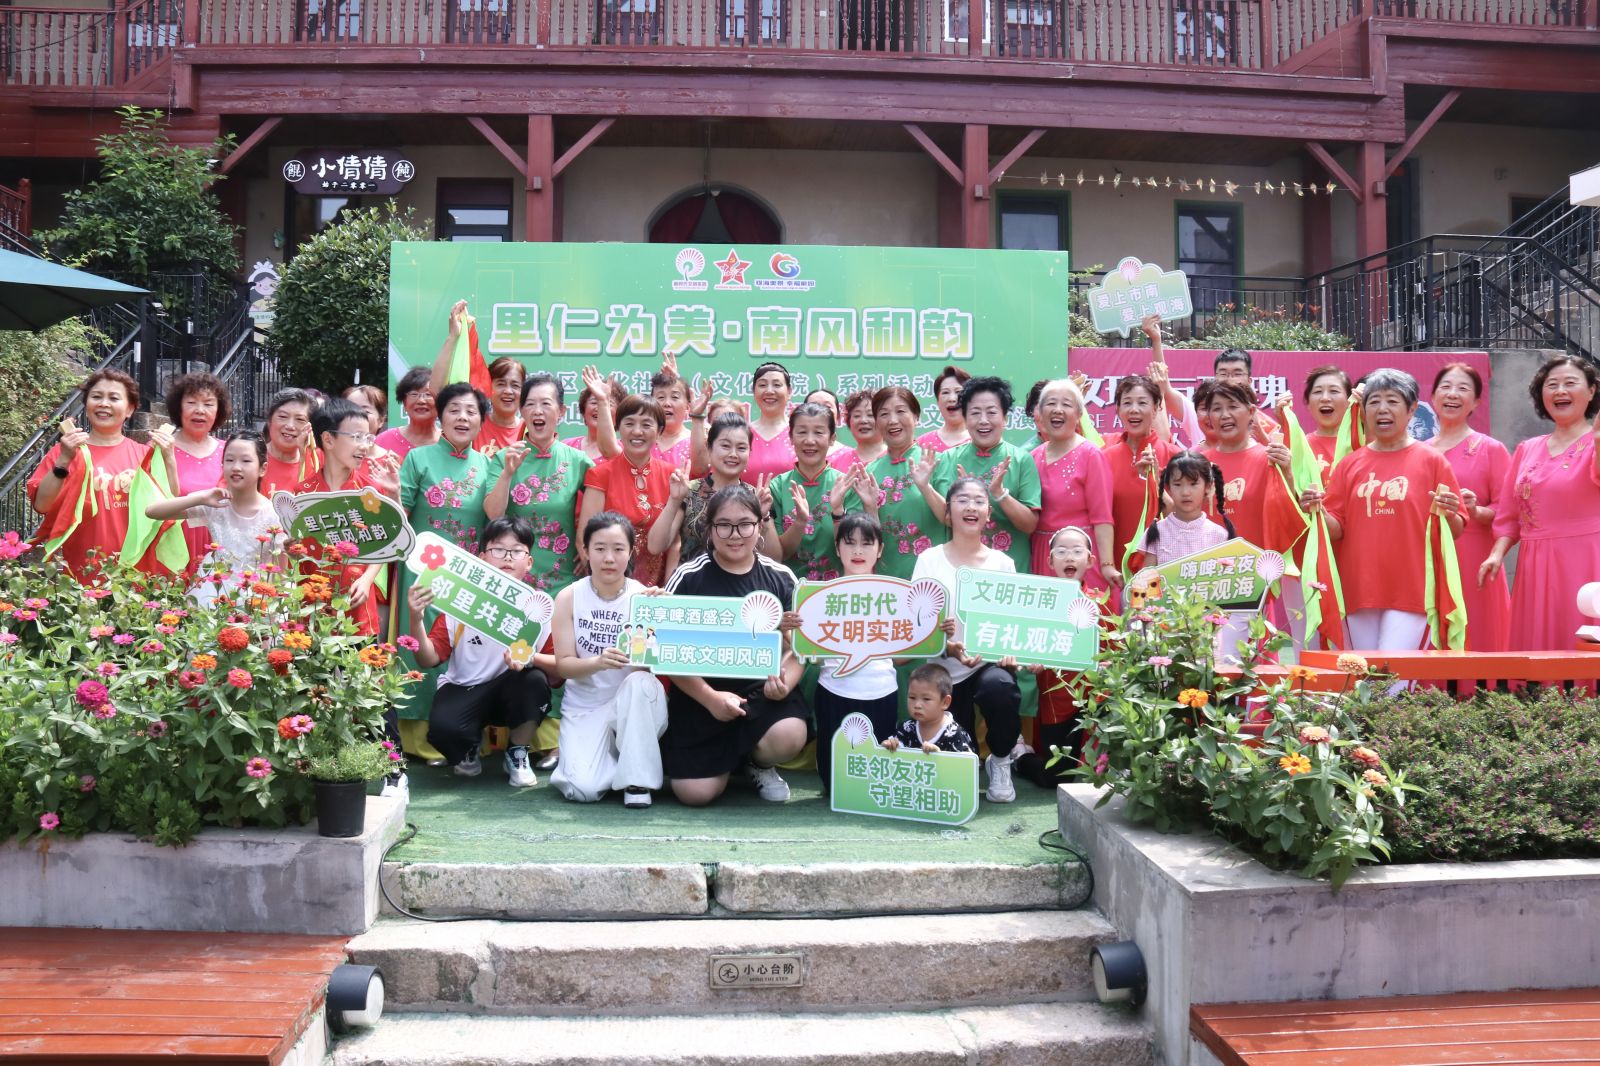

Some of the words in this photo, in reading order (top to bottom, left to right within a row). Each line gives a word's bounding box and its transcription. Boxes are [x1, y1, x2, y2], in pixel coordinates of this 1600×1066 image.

[311, 155, 388, 180] 小倩倩
[1097, 284, 1159, 309] 爱上市南
[489, 302, 973, 358] 里仁为美·南风和韵
[1357, 472, 1409, 518] 中国
[304, 509, 364, 532] 里仁为美
[326, 524, 388, 546] 南风和韵
[449, 556, 523, 605] 和谐社区
[825, 593, 897, 617] 新时代
[971, 579, 1059, 610] 文明市南
[431, 575, 524, 640] 邻里共建
[591, 610, 624, 623] WHERE
[636, 607, 735, 626] 共享啤酒盛会
[578, 618, 623, 633] GRASSROO
[817, 620, 914, 643] 文明实践
[577, 636, 605, 655] GREAT
[590, 632, 617, 644] MEETS
[976, 621, 1073, 656] 有礼观海
[659, 644, 773, 667] 同筑文明风尚
[847, 755, 936, 785] 睦邻友好
[870, 783, 960, 815] 守望相助
[744, 963, 794, 975] 小心台阶
